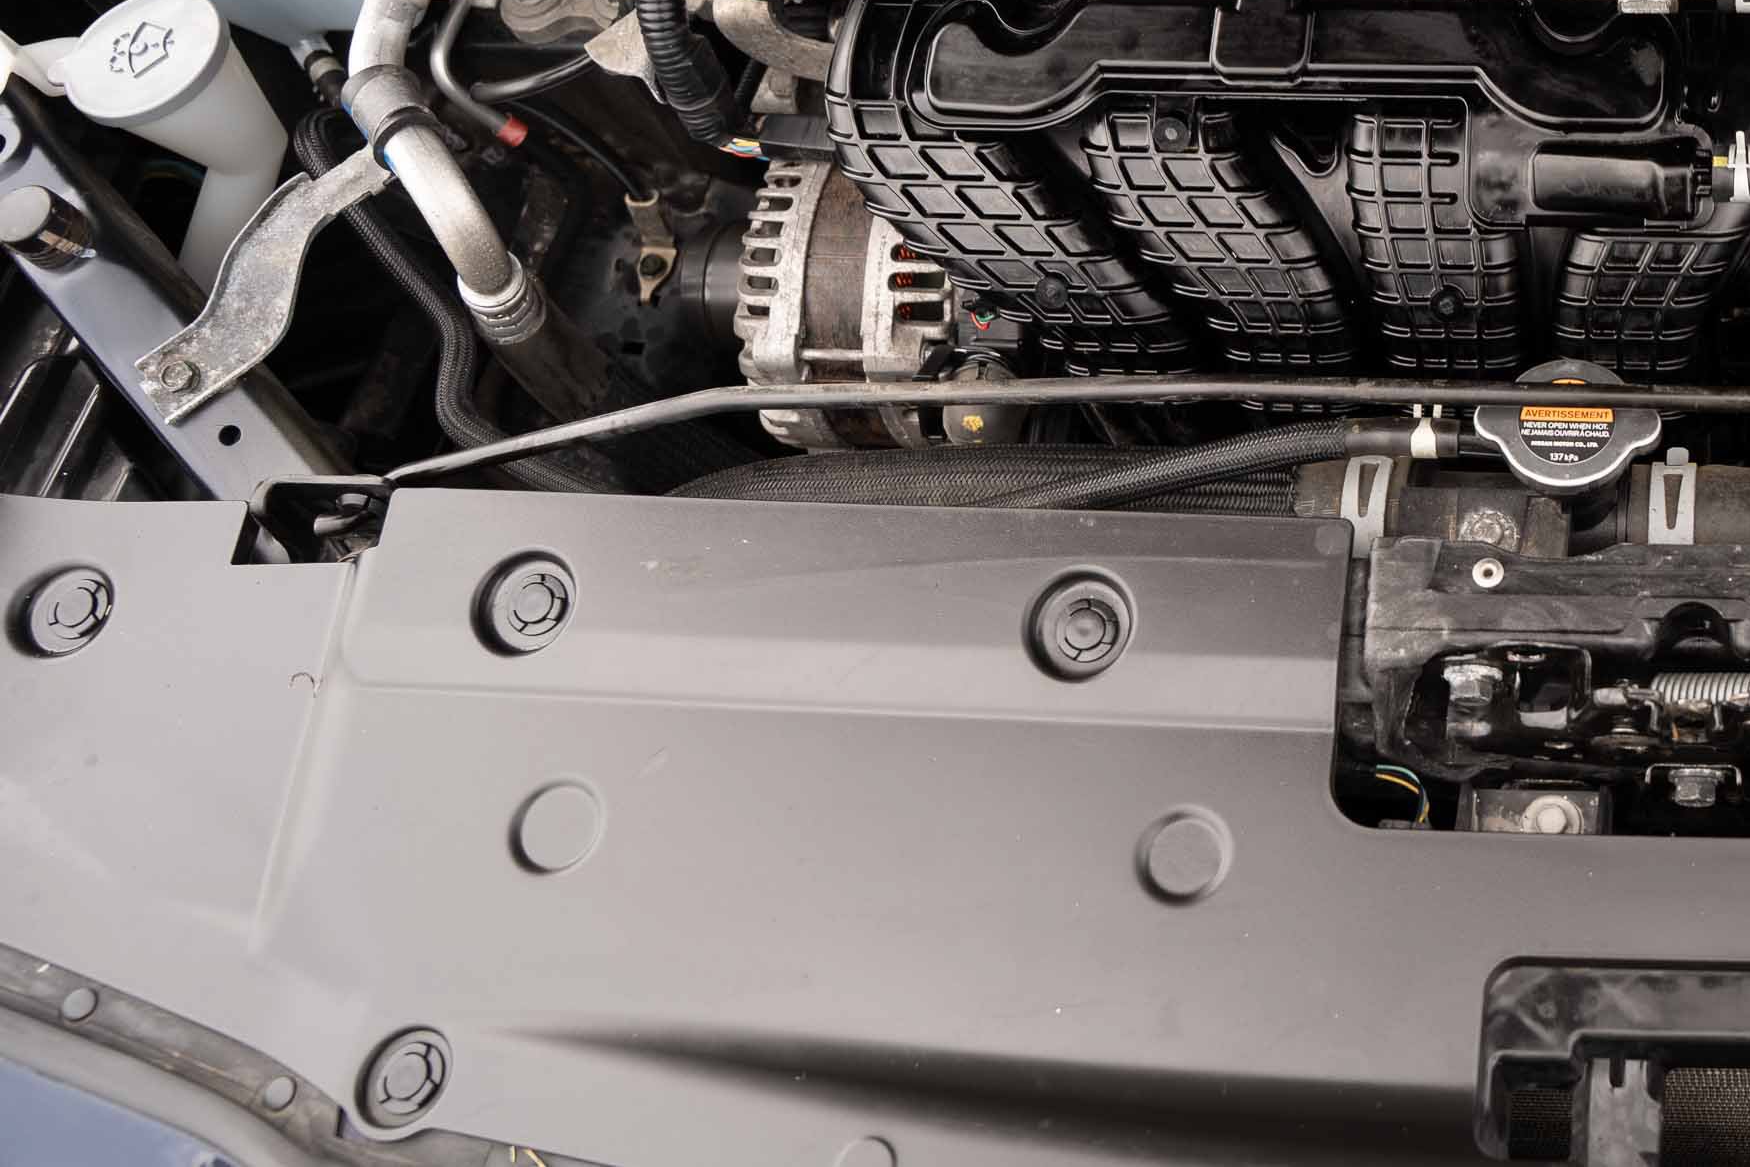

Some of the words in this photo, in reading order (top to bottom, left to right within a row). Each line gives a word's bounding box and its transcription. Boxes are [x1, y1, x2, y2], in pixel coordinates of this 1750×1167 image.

[1525, 409, 1610, 420] AVERTISSEMENT
[1523, 421, 1547, 429] NEVER
[1569, 422, 1591, 430] WHEN
[1550, 452, 1564, 461] 137
